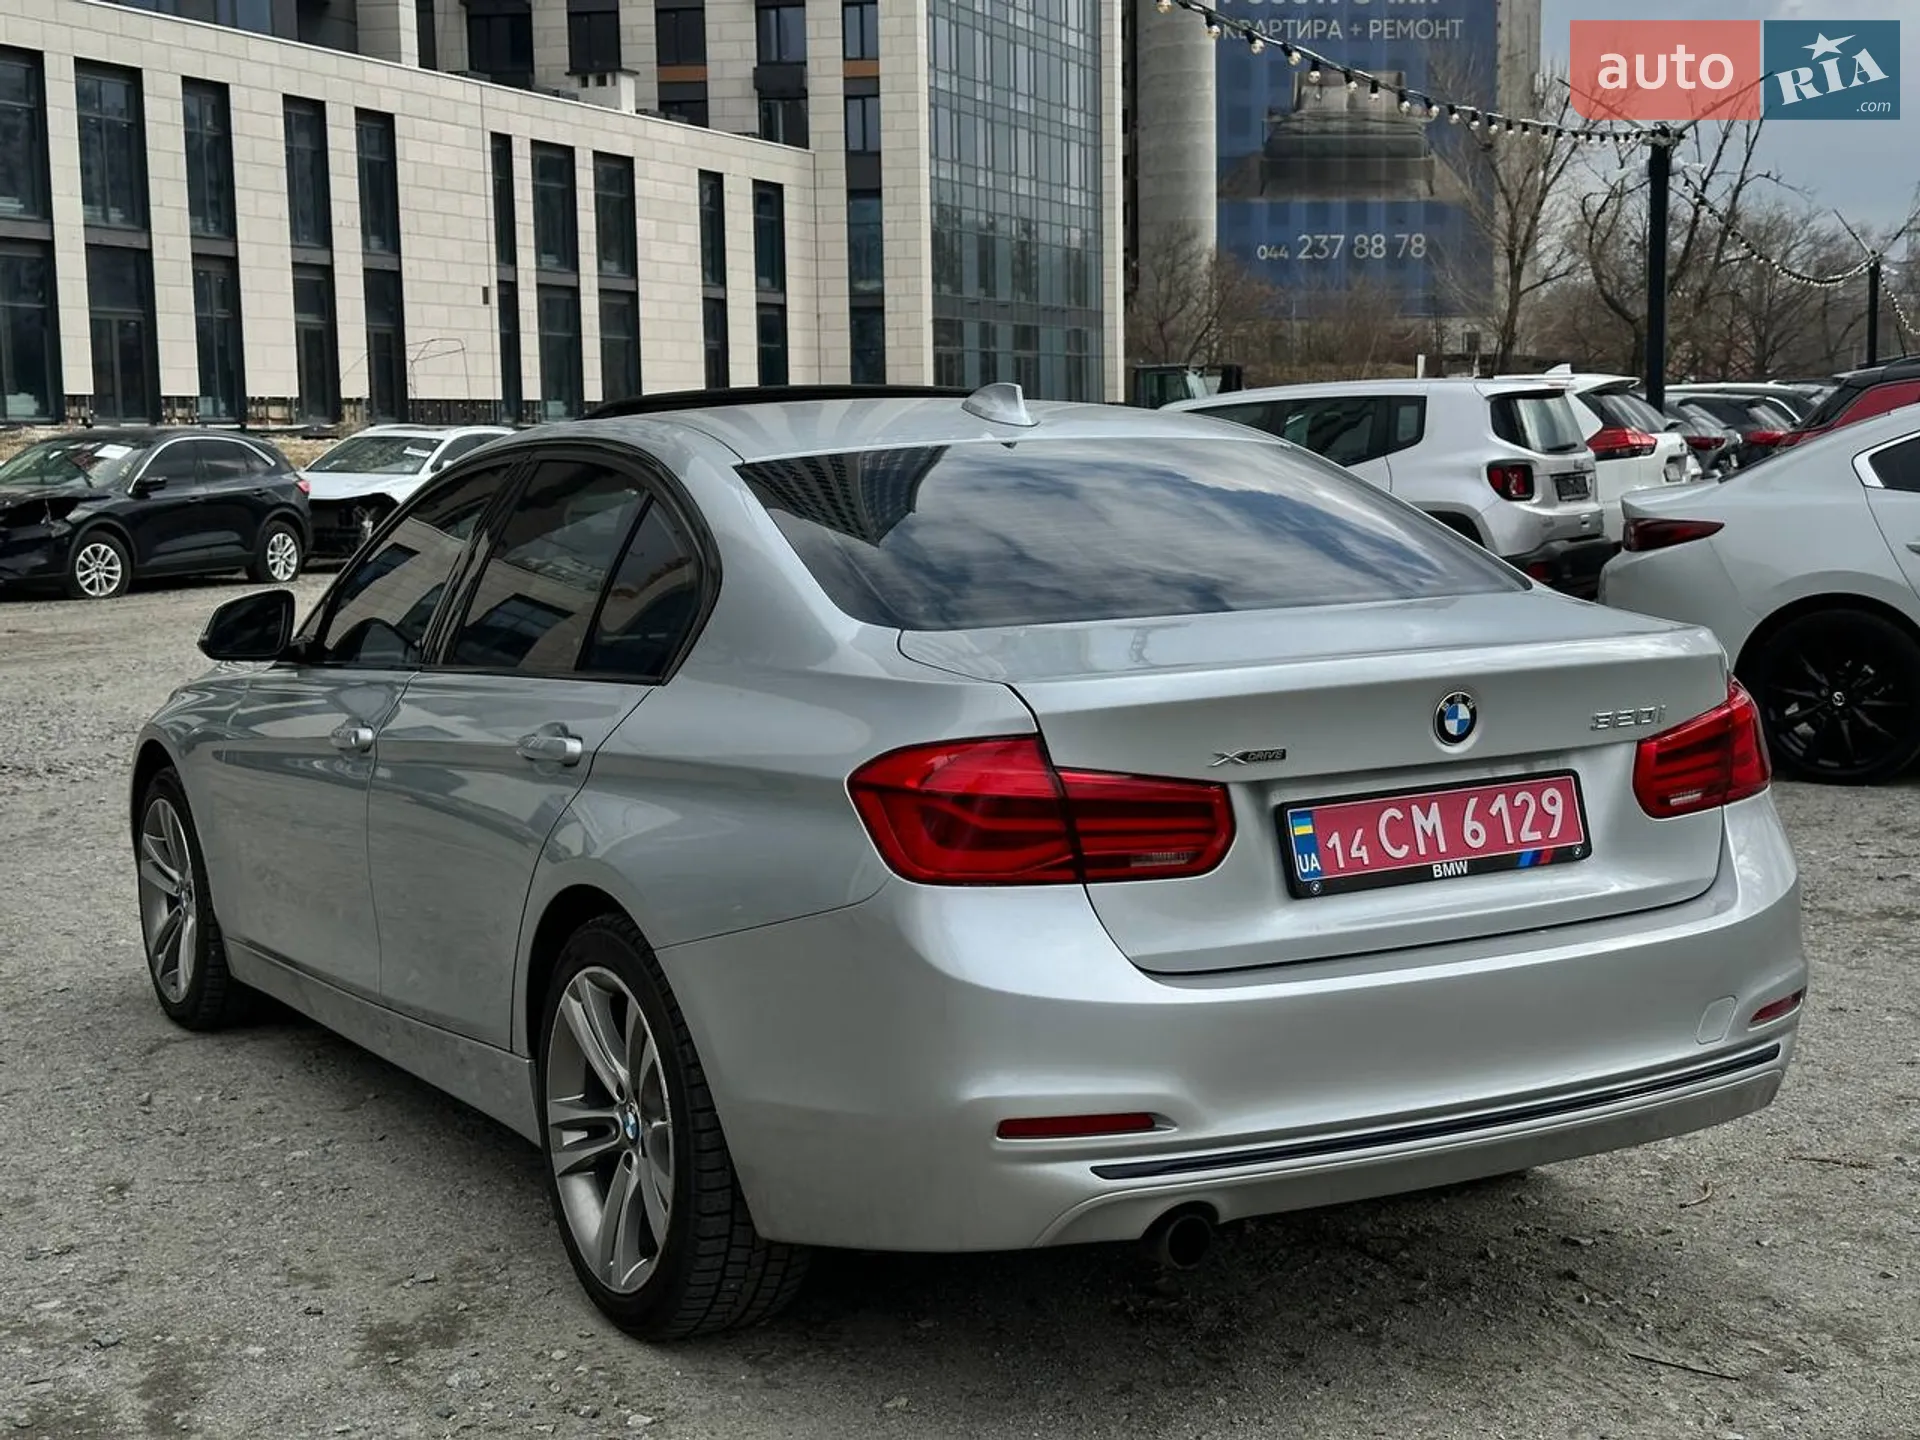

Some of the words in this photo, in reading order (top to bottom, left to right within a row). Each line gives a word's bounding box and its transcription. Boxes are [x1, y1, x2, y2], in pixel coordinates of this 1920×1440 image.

[1368, 19, 1464, 40] РЕМОНТ
[1256, 244, 1289, 260] 044
[1296, 234, 1345, 259] 237
[1353, 233, 1387, 259] 88
[1394, 233, 1427, 259] 78
[1326, 828, 1370, 869] 14
[1378, 802, 1447, 859] CM
[1463, 787, 1564, 850] 6129
[1299, 853, 1322, 873] UA
[1432, 860, 1469, 879] BMW
